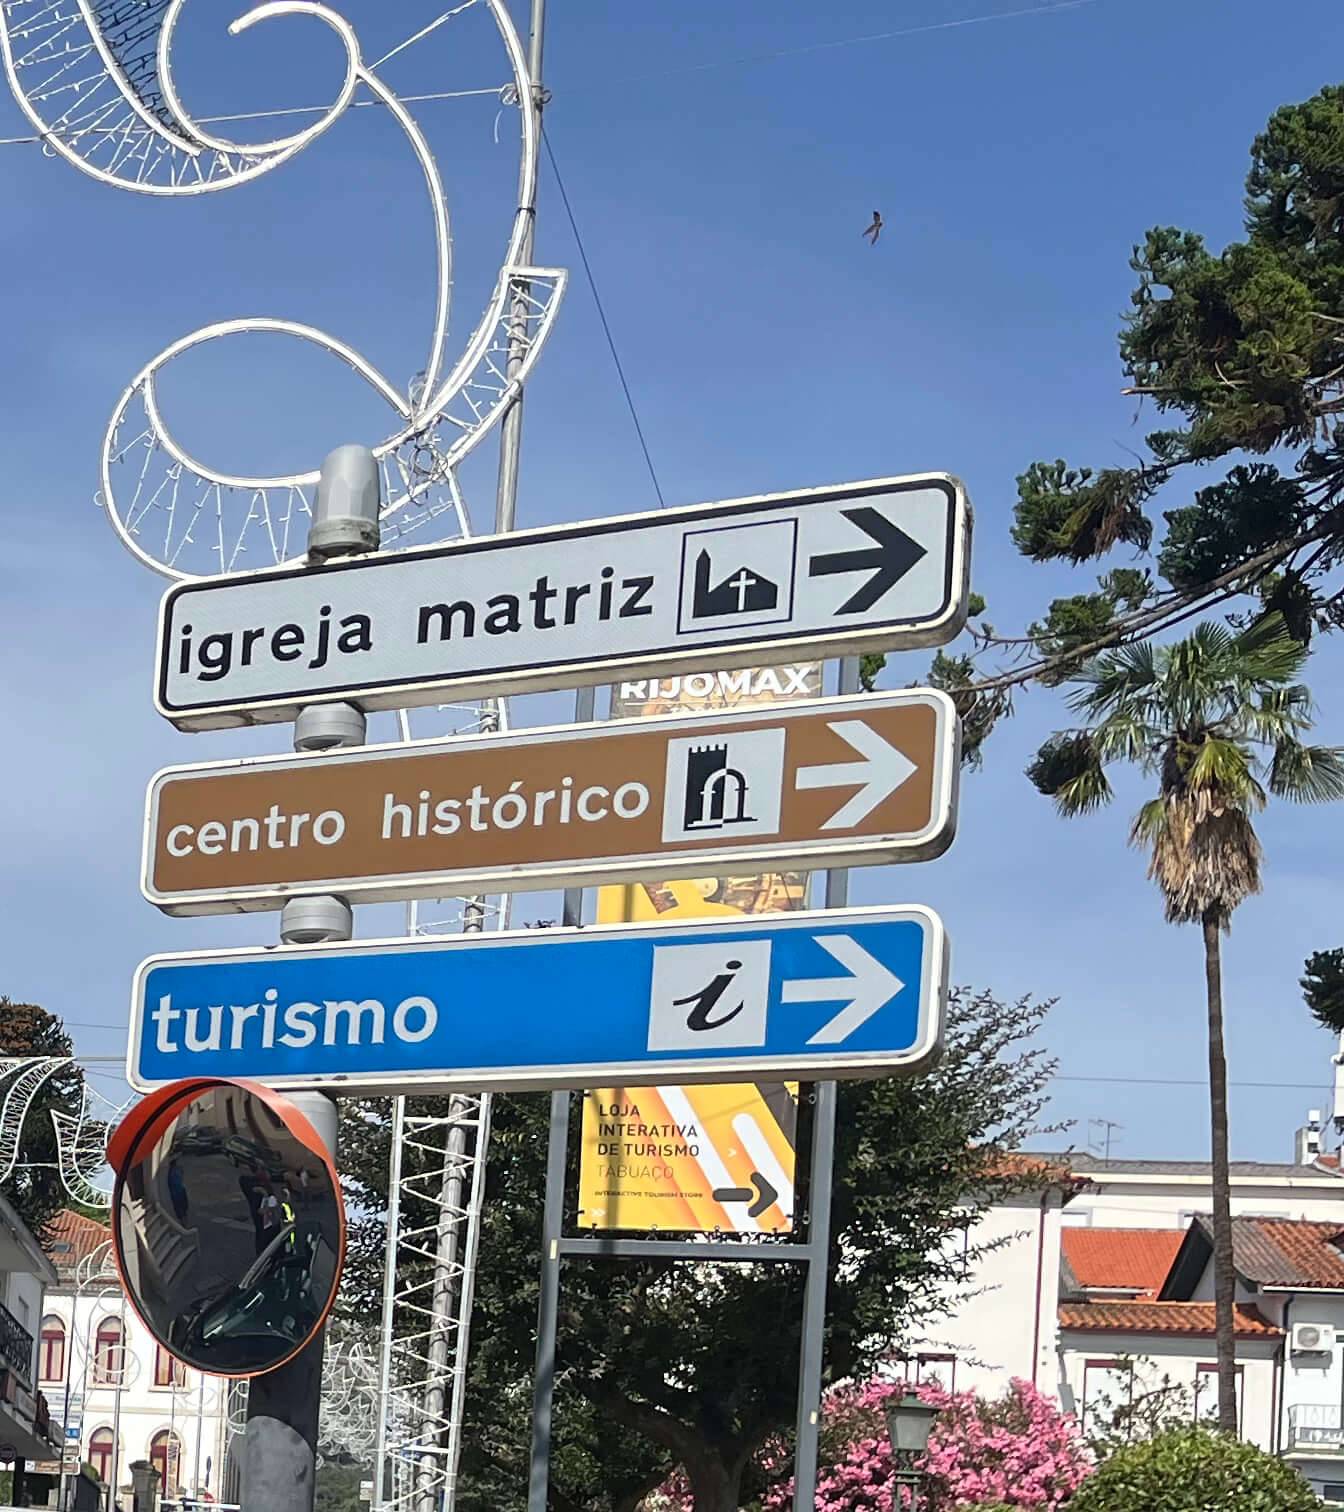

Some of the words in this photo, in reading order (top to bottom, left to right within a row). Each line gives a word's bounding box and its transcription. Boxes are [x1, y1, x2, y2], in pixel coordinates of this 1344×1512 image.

[179, 605, 373, 682] igreja
[416, 565, 655, 647] matriz
[620, 666, 811, 700] RIJOMAX
[166, 804, 346, 859] centro
[381, 775, 651, 841] histórico
[150, 987, 439, 1054] turismo
[599, 1104, 640, 1117] LOJA
[598, 1124, 698, 1137] INTERATIVA
[597, 1142, 618, 1157] DE
[624, 1143, 700, 1158] TURISMO
[598, 1166, 673, 1181] TABUAÇO
